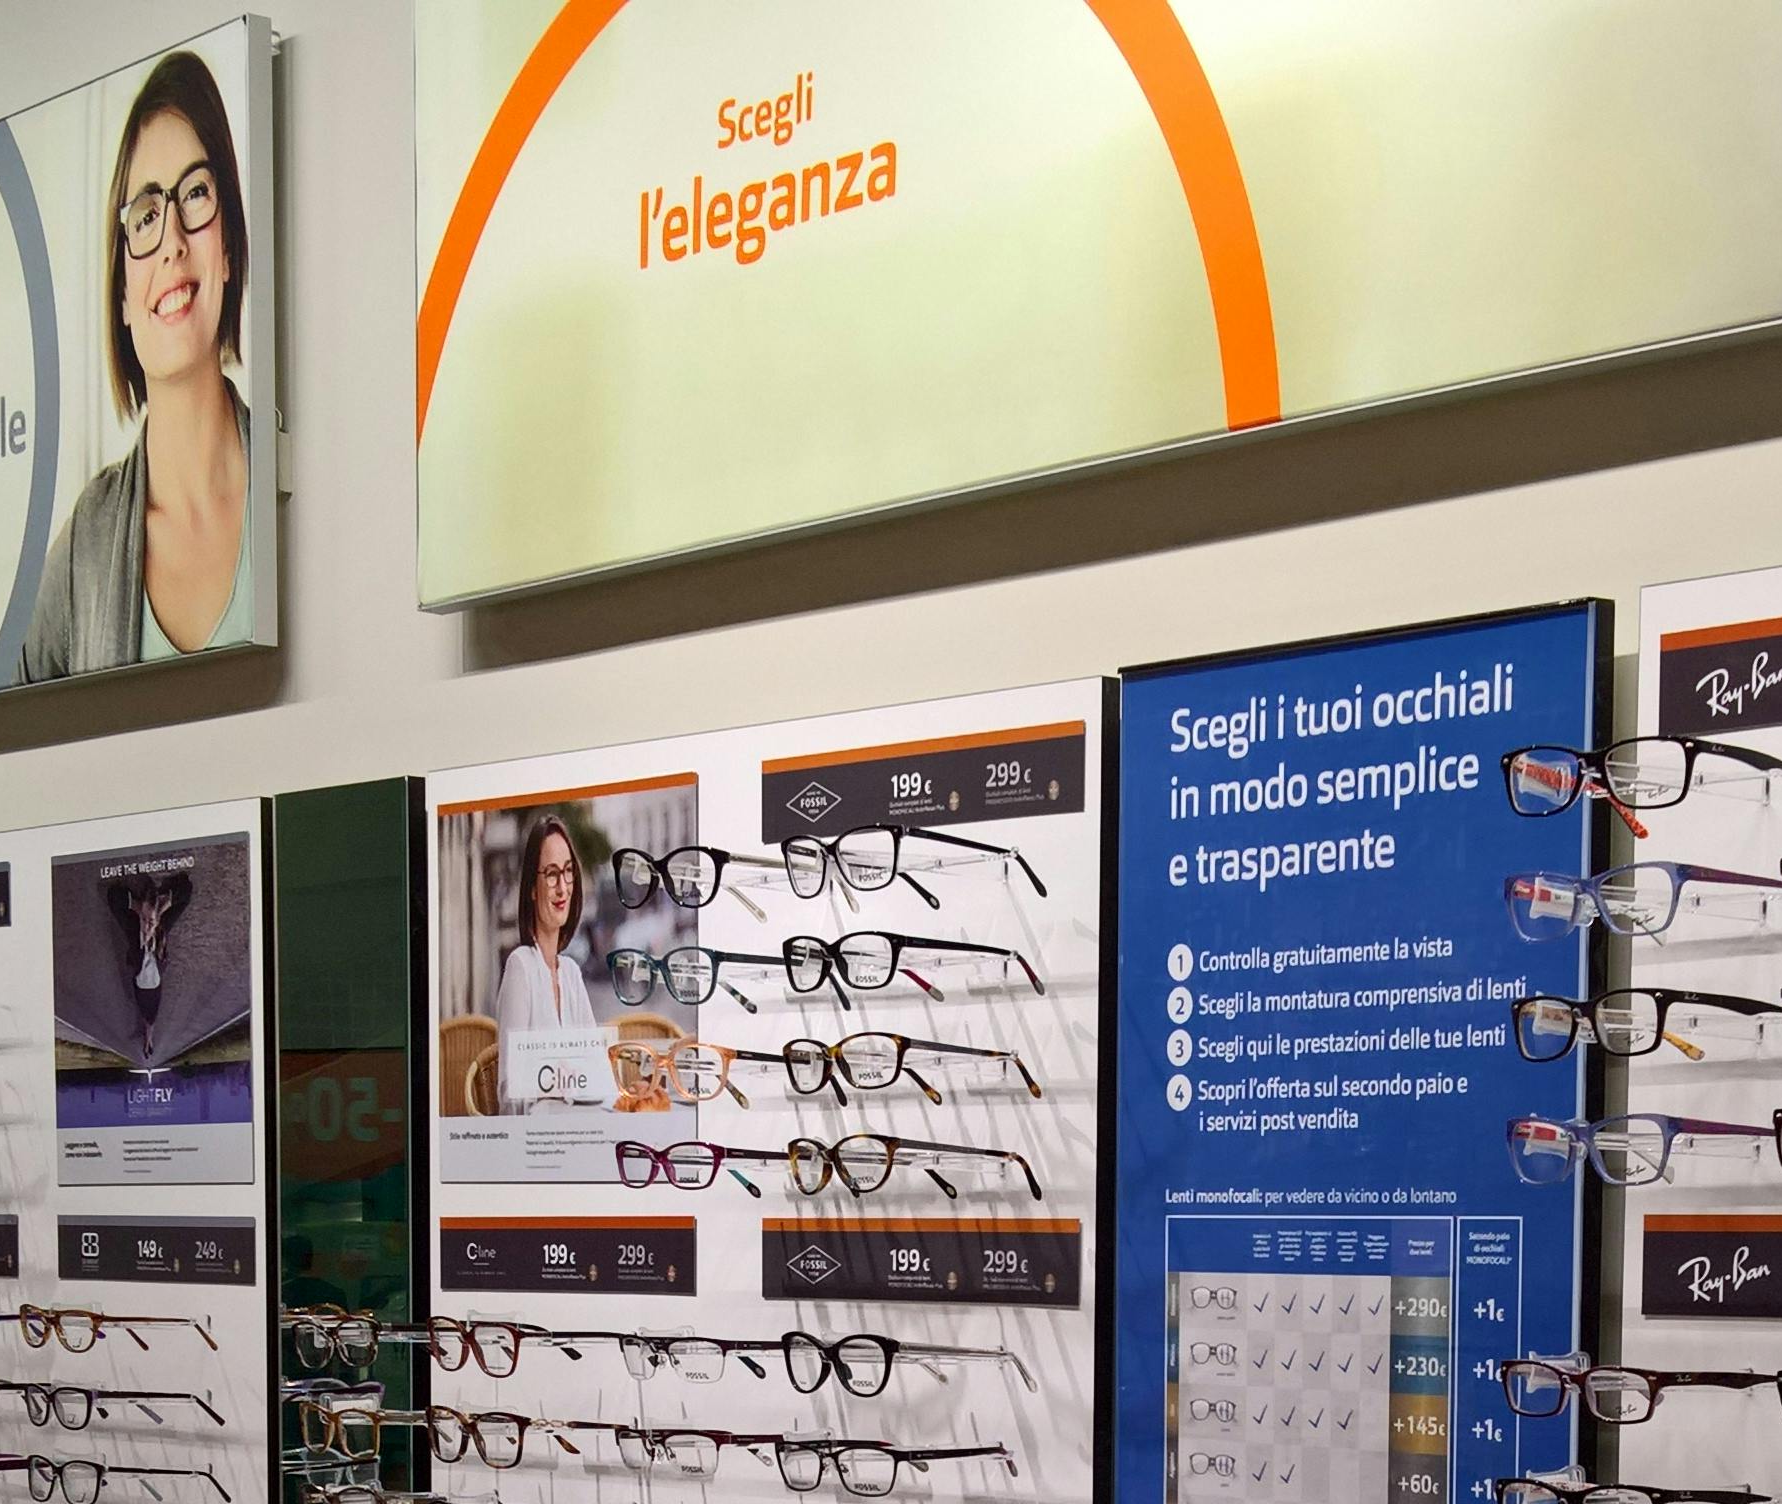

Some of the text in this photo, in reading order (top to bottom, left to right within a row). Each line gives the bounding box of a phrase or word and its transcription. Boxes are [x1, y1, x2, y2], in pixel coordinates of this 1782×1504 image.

[717, 71, 813, 149] Scegli
[640, 142, 896, 269] l'eleganza
[1170, 663, 1513, 760] Scegli i tuoi occhiali
[800, 797, 827, 808] FOSSIL
[890, 772, 921, 799] 199
[986, 761, 1020, 787] 299
[1170, 745, 1479, 820] in modo semplice
[100, 856, 194, 878] LEAVE THE WEIGHT BEHIND
[1169, 829, 1395, 892] e trasparente
[1199, 936, 1453, 974] Controlla gratuitamente la vista
[1199, 975, 1526, 1020] Scegli la montatura comprensiva di lenti
[1199, 1023, 1506, 1063] Scegli qui le prestazioni delle tue lenti
[1198, 1072, 1468, 1106] Scopri l'offerta sul secondo paio e
[1199, 1107, 1359, 1136] i servizi post vendita
[1165, 1188, 1457, 1207] Lenti monofocali: per vedere da vicino o da lontano
[1395, 1296, 1504, 1322] +290€ +1€
[1394, 1356, 1447, 1378] +230€
[1393, 1415, 1446, 1437] +145€
[1397, 1474, 1439, 1495] +60€
